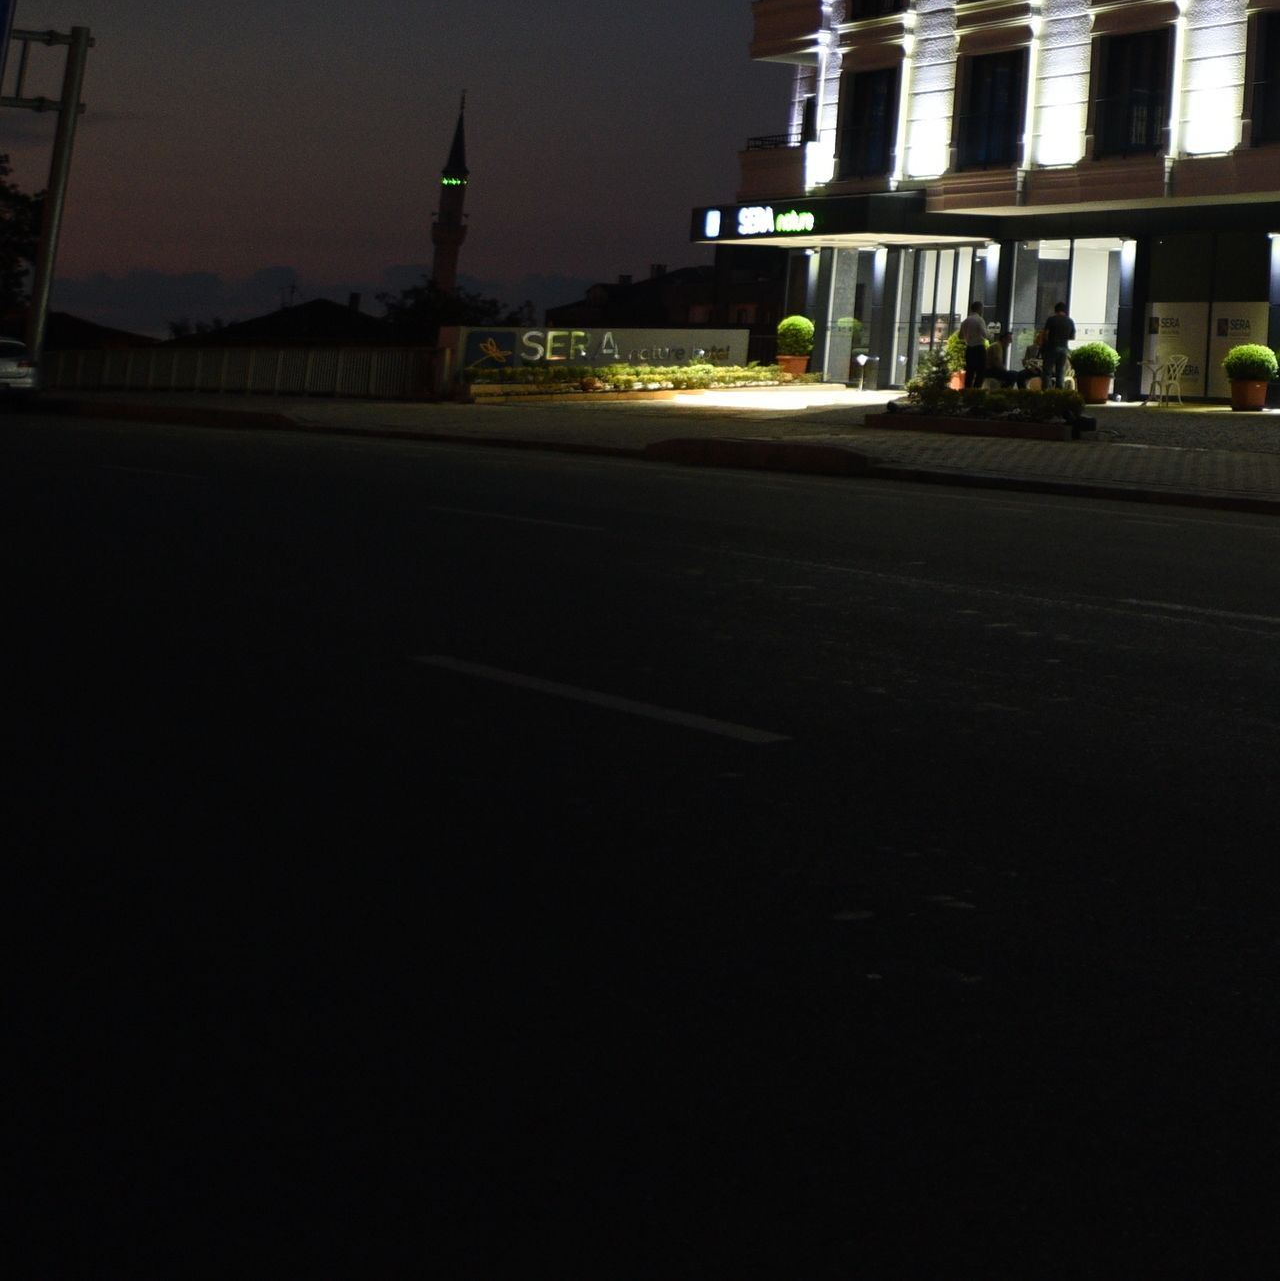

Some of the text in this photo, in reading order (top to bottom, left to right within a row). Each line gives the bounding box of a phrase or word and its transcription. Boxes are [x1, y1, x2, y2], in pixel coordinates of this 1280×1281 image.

[1161, 318, 1180, 328] SERA
[1230, 319, 1250, 330] SERA
[520, 330, 621, 361] SERA
[628, 346, 685, 361] nature
